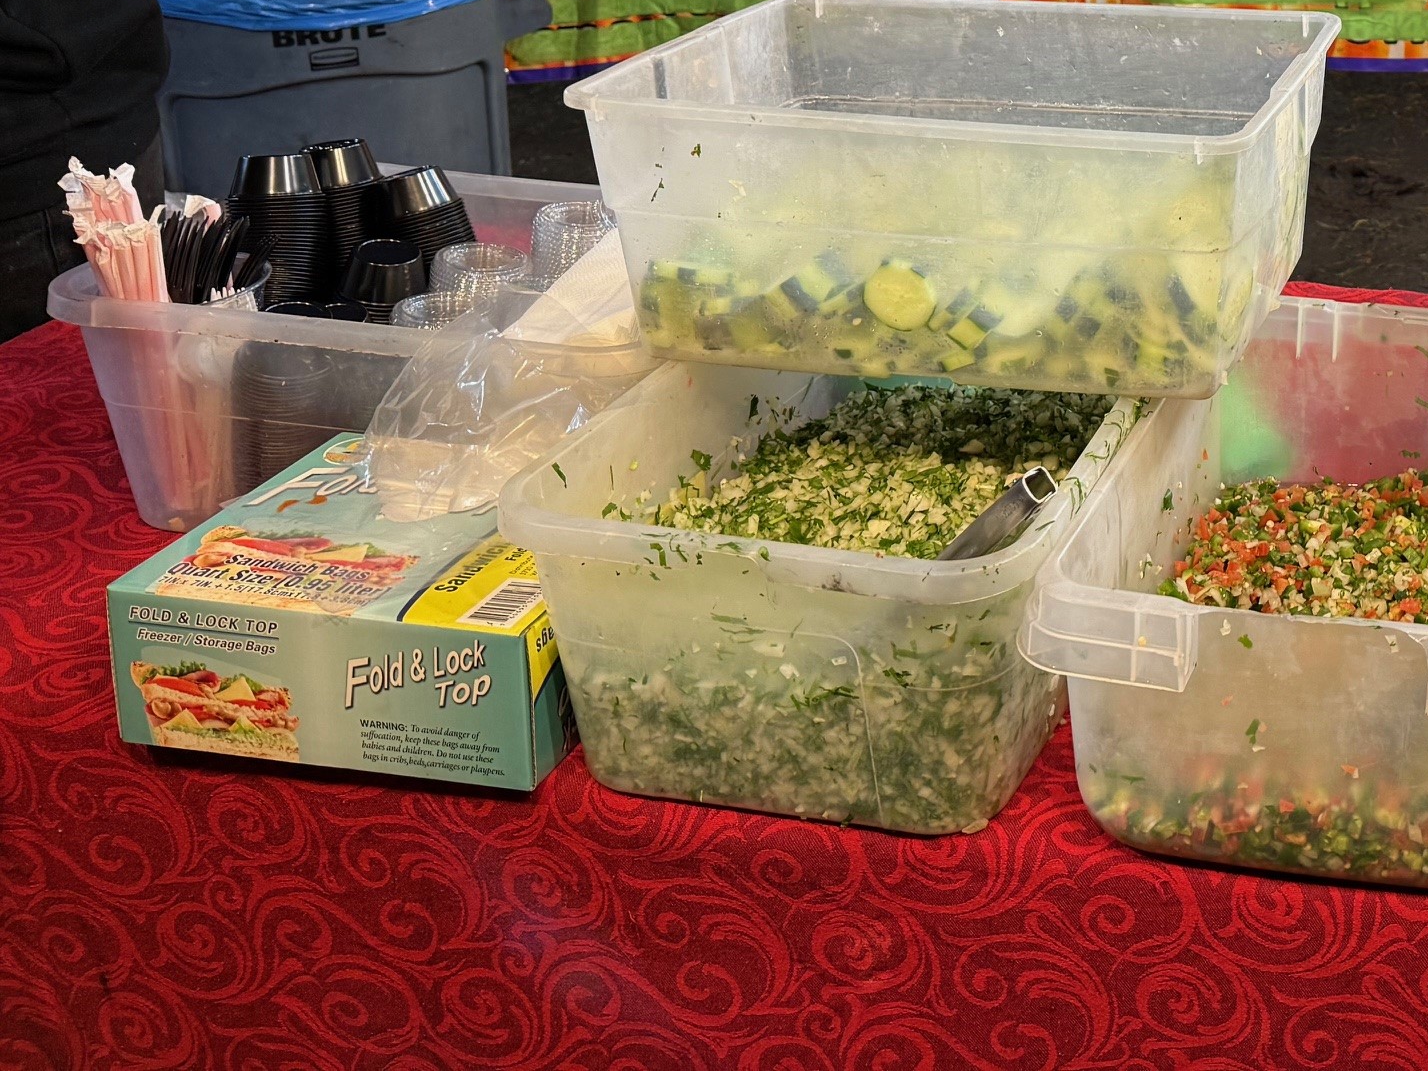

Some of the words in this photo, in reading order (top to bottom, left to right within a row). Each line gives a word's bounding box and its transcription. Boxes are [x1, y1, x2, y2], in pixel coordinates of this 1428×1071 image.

[166, 562, 231, 581] Quart
[229, 567, 274, 585] Size
[225, 554, 318, 574] Sandwich
[319, 565, 371, 582] Bags
[129, 606, 172, 623] FOLD
[178, 611, 189, 625] &
[196, 614, 239, 631] LOCK
[246, 619, 278, 635] TOP
[137, 628, 183, 644] Freezer
[185, 633, 192, 645] /
[194, 634, 242, 651] Storage
[245, 640, 276, 655] Bags
[344, 651, 404, 710] Fold
[410, 648, 426, 682] &
[433, 639, 486, 679] Lock
[434, 674, 492, 707] Top
[360, 719, 408, 732] WARNING:
[411, 724, 420, 733] To
[421, 726, 443, 735] avoid
[443, 728, 471, 740] danger
[471, 731, 481, 742] of
[360, 730, 403, 744] suffocation,
[405, 734, 421, 746] keep
[422, 736, 441, 746] these
[441, 738, 459, 750] bags
[459, 743, 481, 753] away
[481, 743, 500, 754] from
[361, 740, 385, 751] babies
[386, 744, 402, 753] and
[402, 745, 435, 757] children.
[436, 749, 448, 758] Do
[448, 752, 461, 760] not
[462, 754, 475, 762] use
[475, 754, 495, 764] these
[363, 751, 380, 763] bags
[380, 753, 389, 762] in
[470, 764, 505, 776] playpens.
